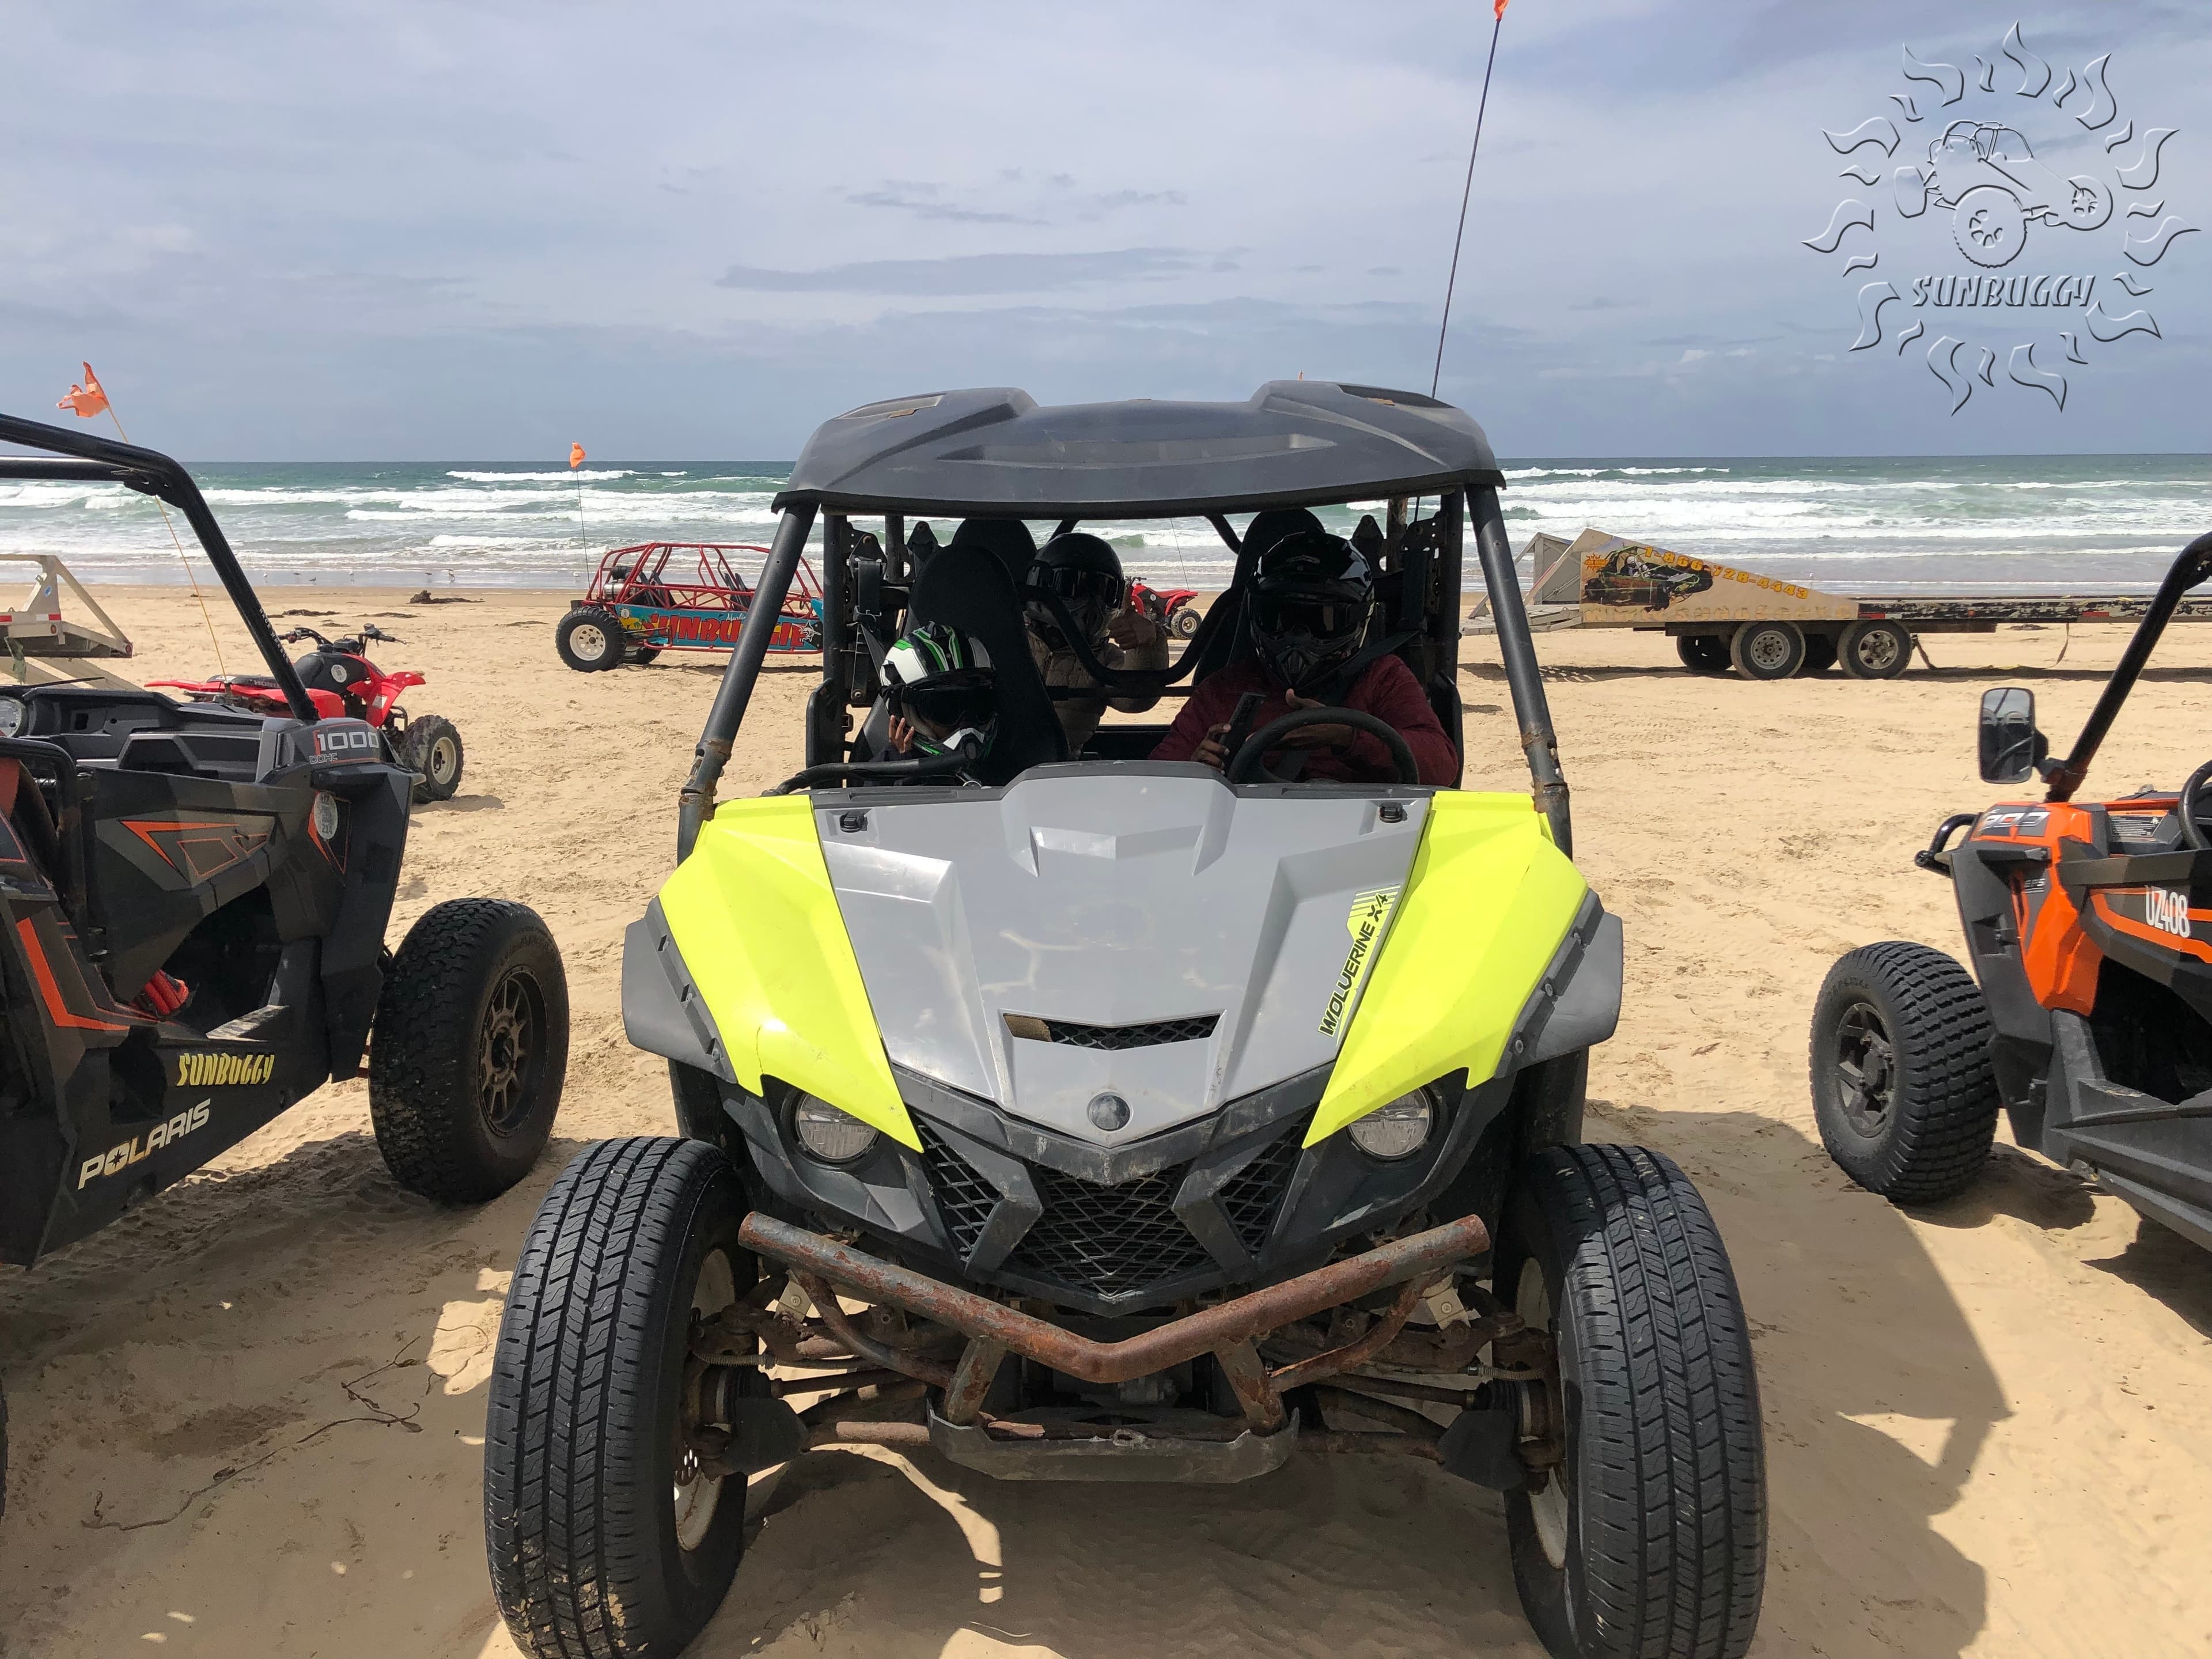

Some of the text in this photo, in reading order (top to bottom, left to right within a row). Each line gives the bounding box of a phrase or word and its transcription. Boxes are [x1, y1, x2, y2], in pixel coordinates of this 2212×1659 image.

[309, 752, 338, 764] DOHC
[317, 732, 379, 751] 1000
[2144, 884, 2190, 938] UZ408
[1319, 893, 1389, 1036] WOLVERINE X4
[176, 1052, 275, 1087] SUNBUGGY
[78, 1098, 211, 1191] POLARIS
